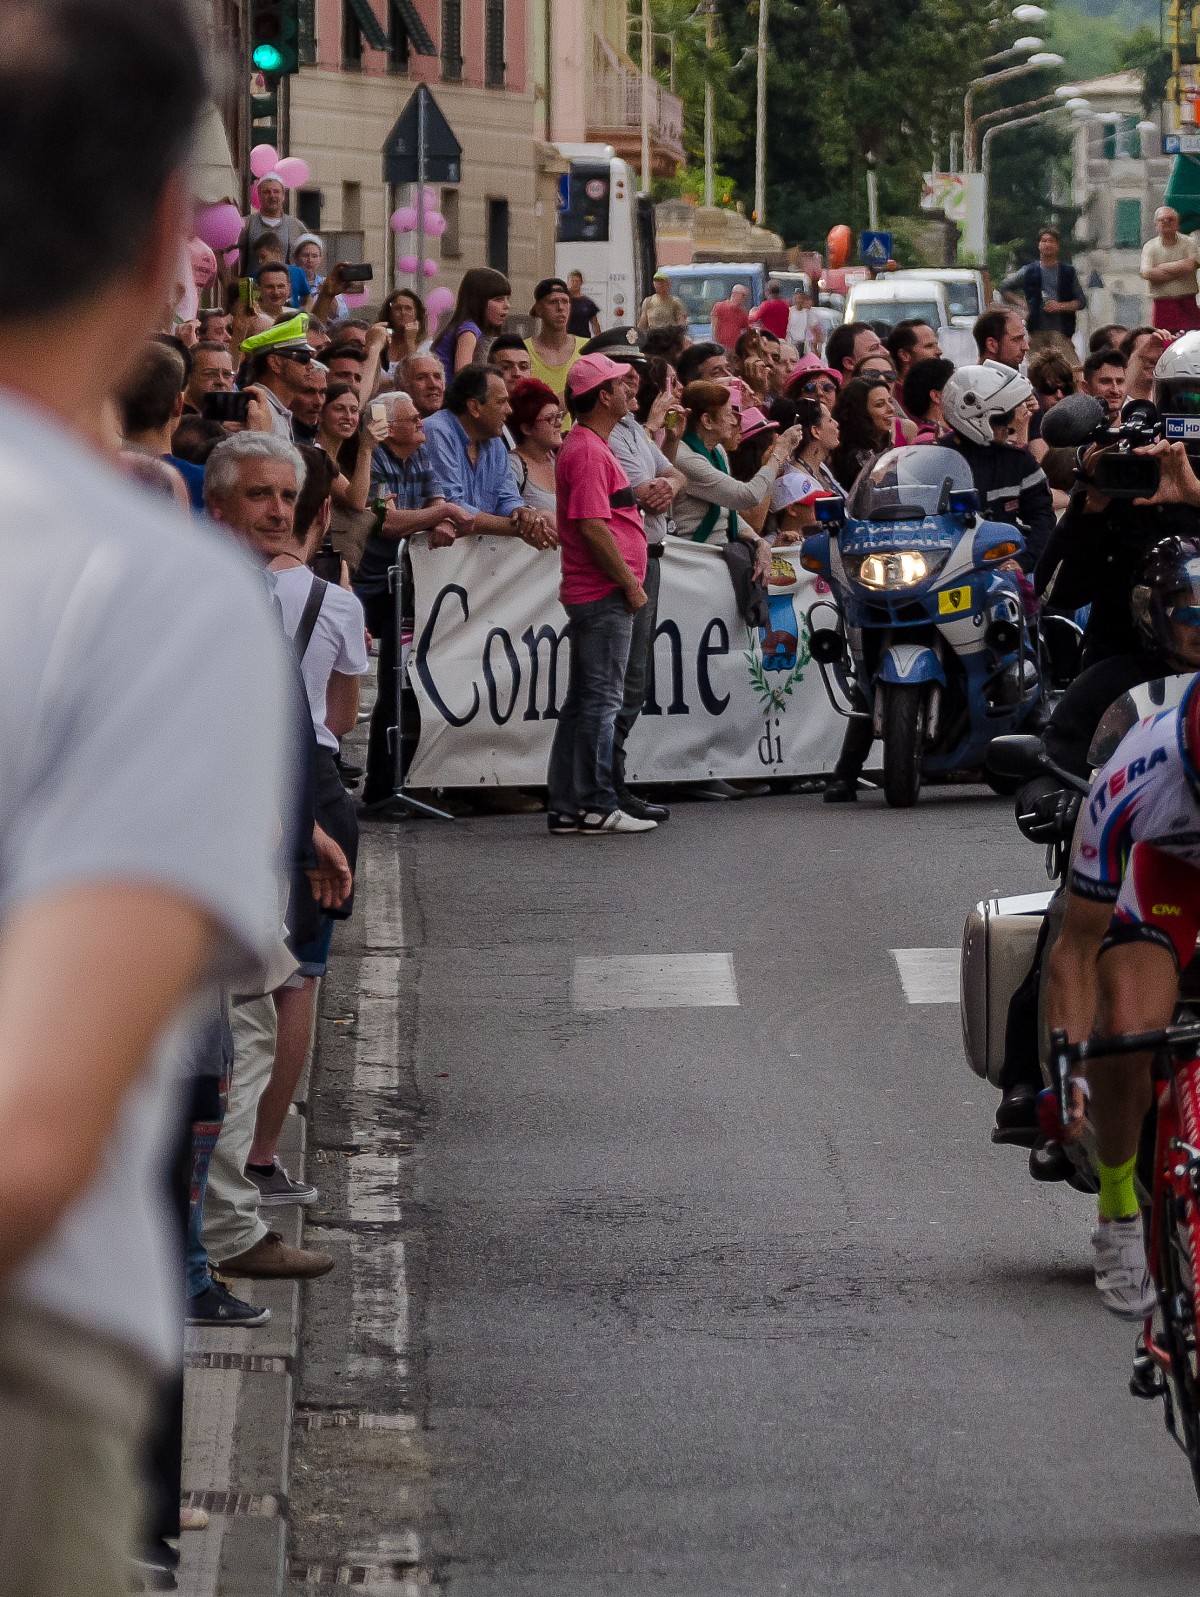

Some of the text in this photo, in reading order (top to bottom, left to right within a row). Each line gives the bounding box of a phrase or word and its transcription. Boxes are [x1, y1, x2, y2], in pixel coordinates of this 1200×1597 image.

[1168, 423, 1200, 432] Rai HD
[416, 583, 731, 727] Comne
[758, 718, 784, 765] di
[1089, 746, 1168, 827] ITERA
